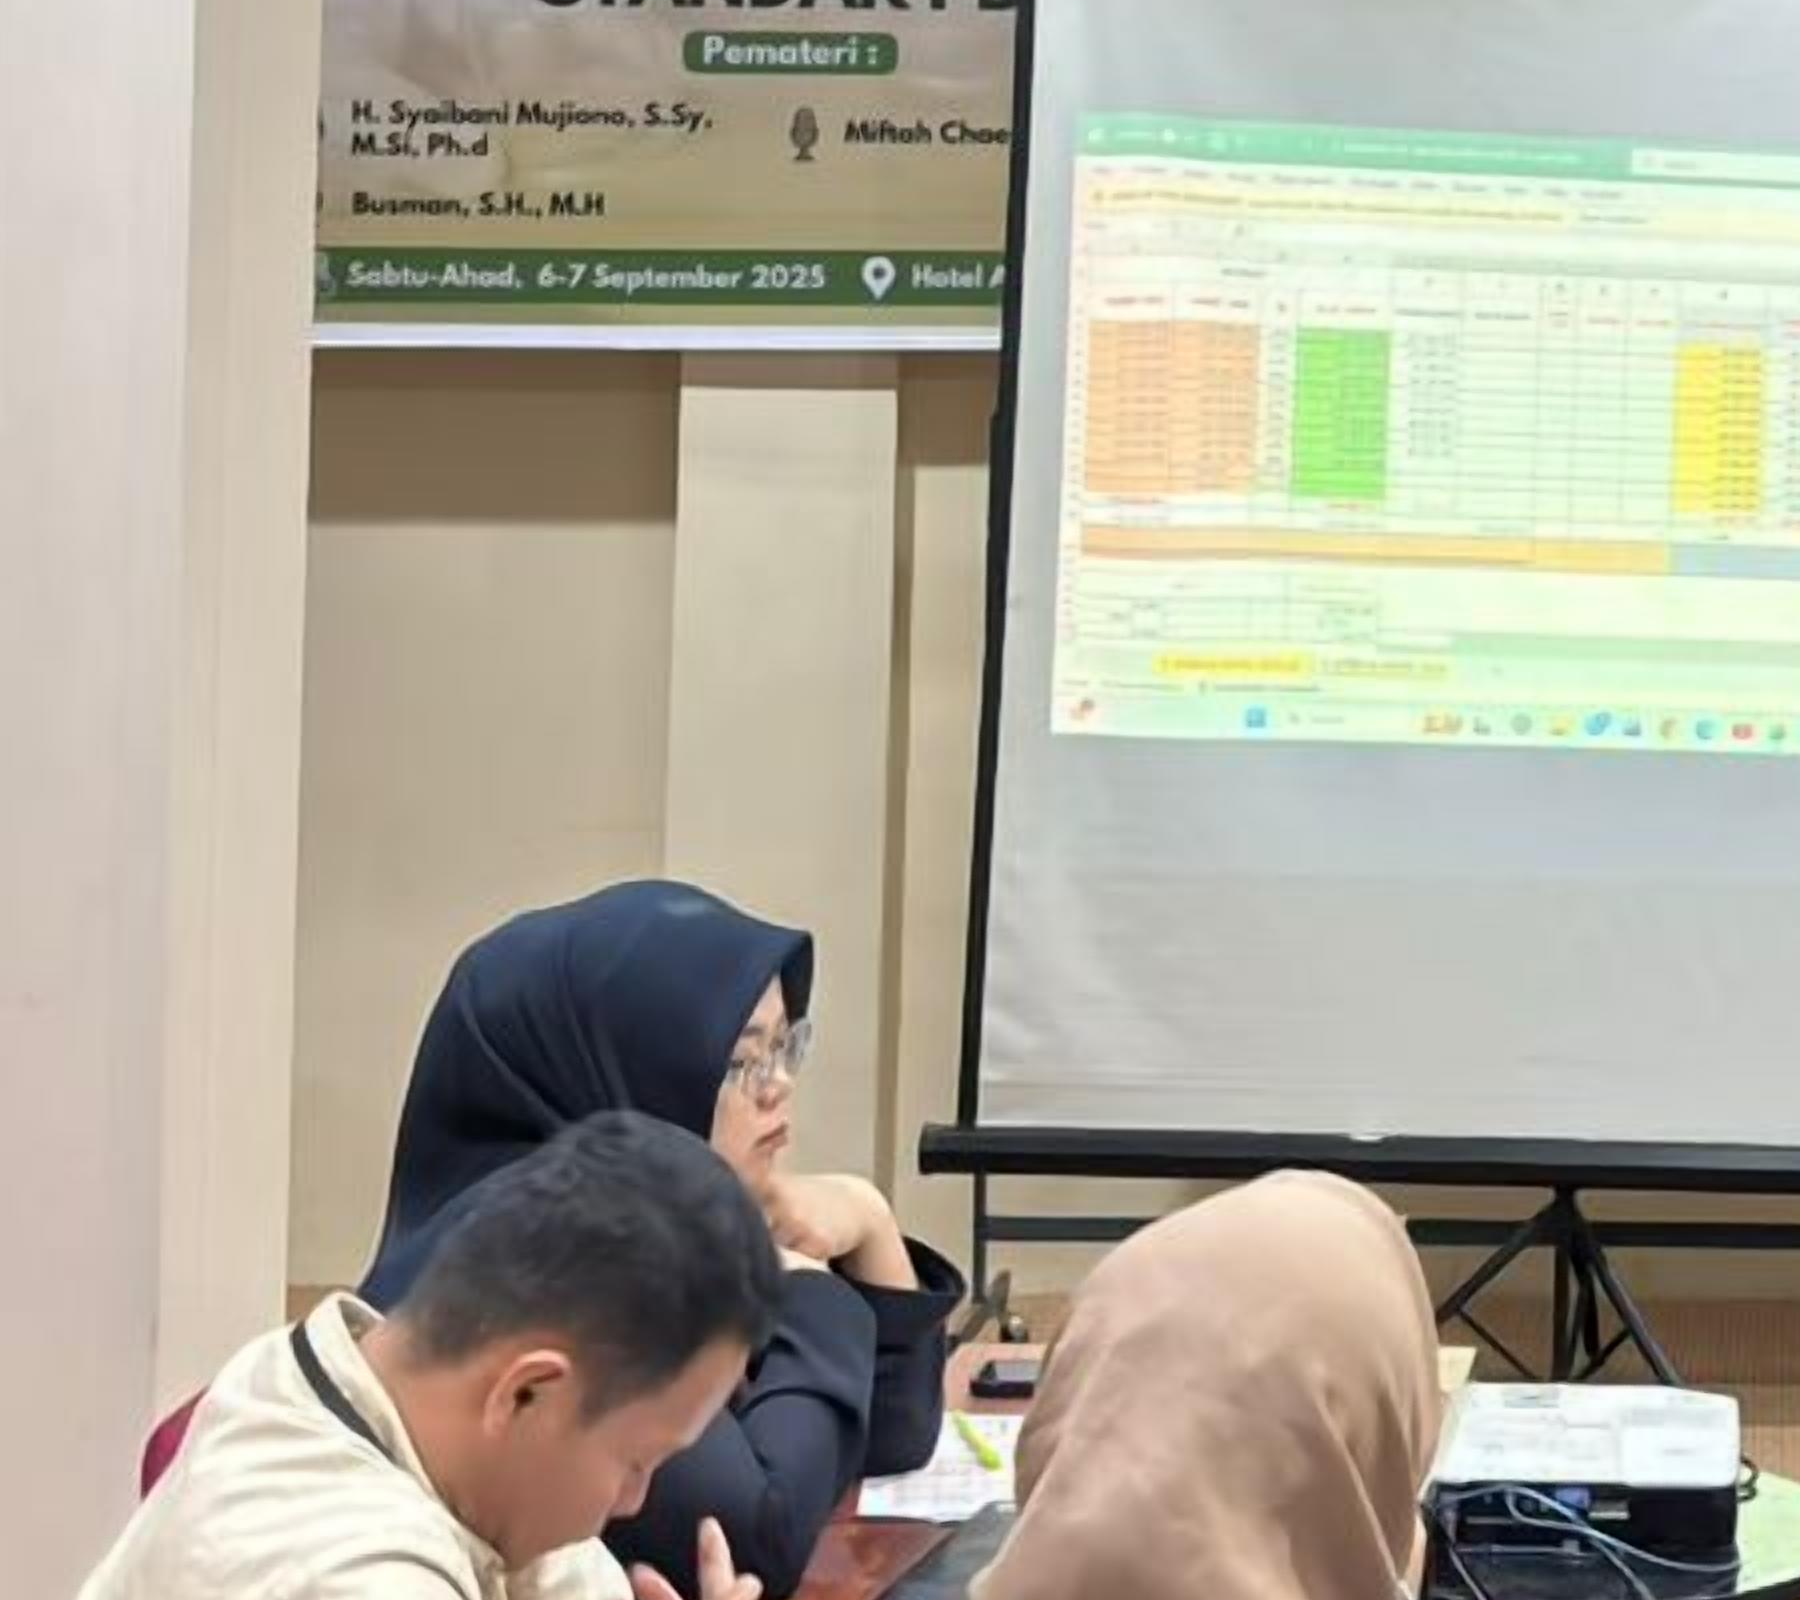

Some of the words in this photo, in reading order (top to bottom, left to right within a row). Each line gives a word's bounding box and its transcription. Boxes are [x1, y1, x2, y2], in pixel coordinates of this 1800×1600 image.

[702, 35, 857, 66] Pemateri
[351, 100, 380, 125] H.
[537, 262, 588, 288] 6-7
[592, 262, 744, 296] September
[750, 264, 826, 289] 2025
[911, 263, 983, 289] Hotel
